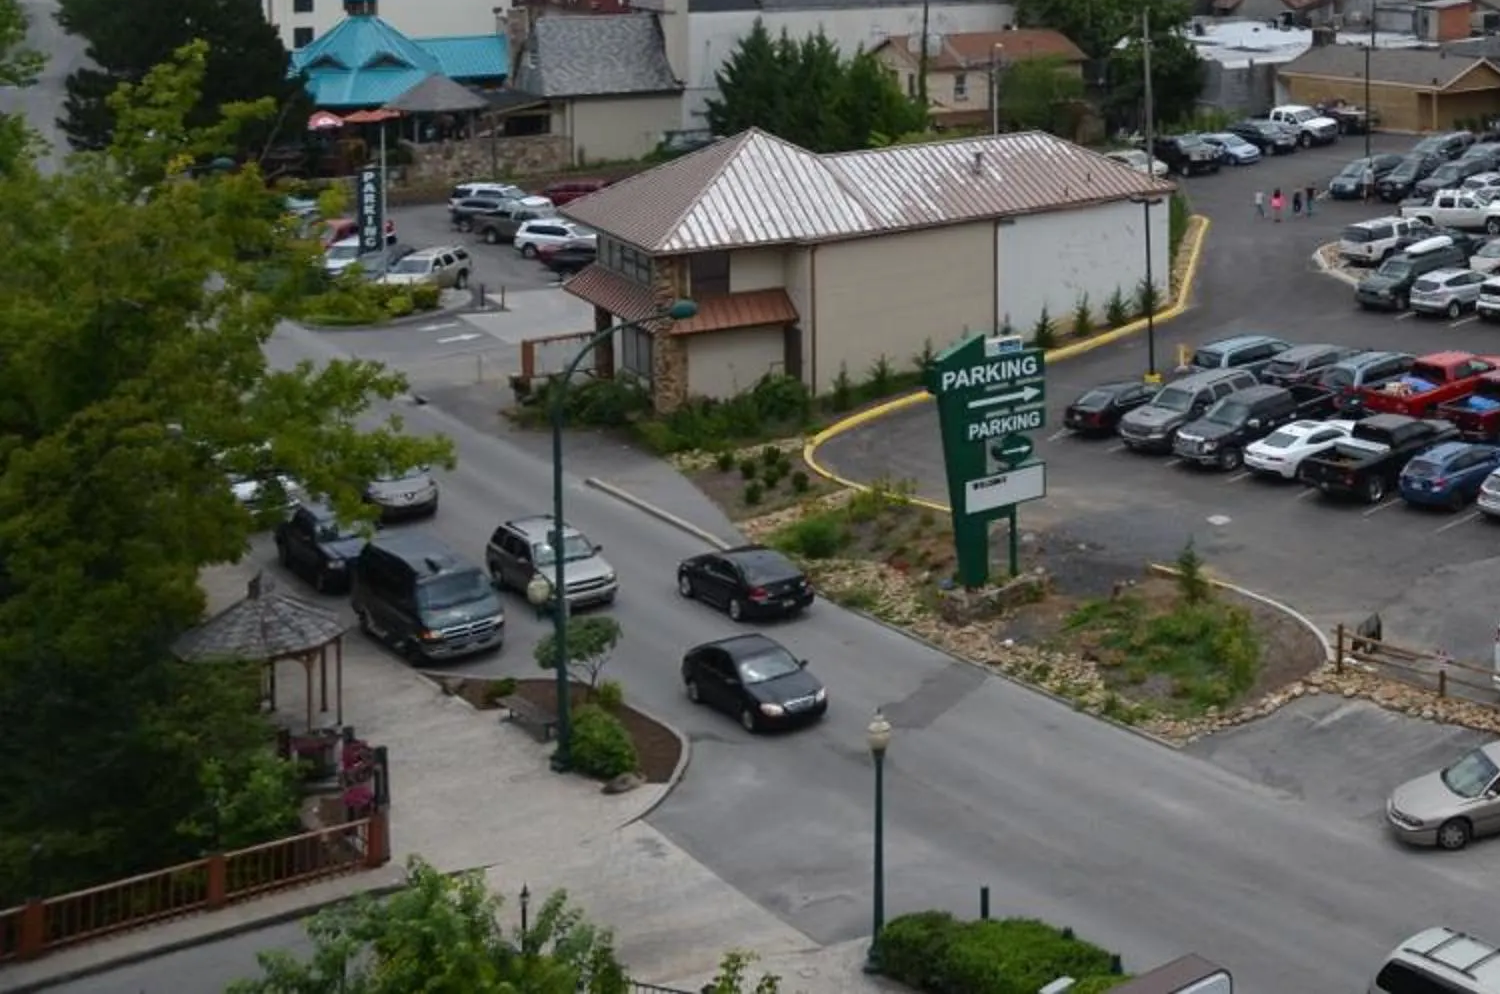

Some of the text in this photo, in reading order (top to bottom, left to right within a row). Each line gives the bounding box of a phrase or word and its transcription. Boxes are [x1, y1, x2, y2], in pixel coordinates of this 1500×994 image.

[363, 171, 377, 247] PARKING
[942, 356, 1038, 391] PARKING
[969, 411, 1041, 440] PARKING
